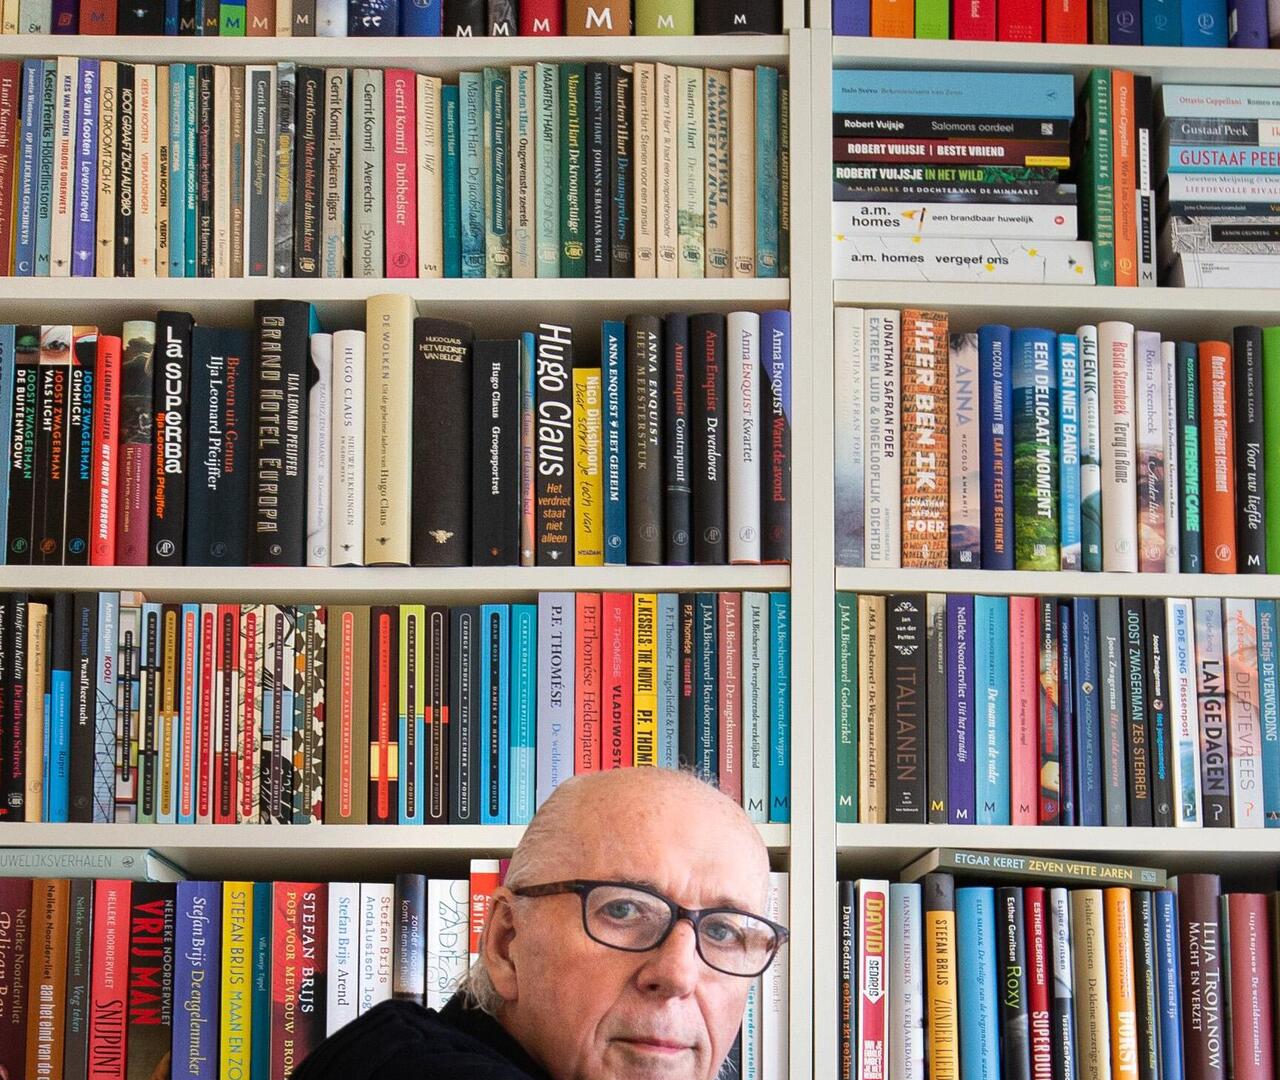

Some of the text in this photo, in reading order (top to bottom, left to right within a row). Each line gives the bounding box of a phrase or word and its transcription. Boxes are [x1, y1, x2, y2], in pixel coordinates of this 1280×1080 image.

[79, 71, 95, 221] Kees van Kooten Levensnevel
[393, 80, 408, 225] Gerrit Komrij Dubbelster
[848, 144, 1004, 157] ROBERT VUIJSJE BESTE VRIEND
[1180, 151, 1246, 166] GUSTAAF
[1181, 124, 1248, 136] Gustaaf Peek
[851, 217, 900, 227] homes
[851, 253, 1008, 265] a.m. homes vergeef ons
[860, 207, 891, 215] a.m.
[204, 356, 222, 490] Ilja Leonard Pfeijffer
[256, 316, 283, 532] GRAND HOTEL EUROPA
[536, 323, 571, 476] Hugo Claus
[914, 321, 936, 488] HIER BEN IK
[1035, 342, 1051, 518] EEN DELICAAT MOMENT
[549, 606, 566, 708] P.F. THOMÉSE
[637, 649, 654, 692] THE NOVEL
[1128, 610, 1147, 798] JOOST ZWAGERMAN ZES STERREN
[896, 666, 918, 780] ITALIANEN
[1202, 660, 1224, 790] LANGE DAGEN
[129, 901, 164, 1024] VRIJ MAN
[866, 897, 883, 953] DAVID
[91, 999, 123, 1077] SNIJPUNT
[1005, 965, 1023, 1008] Roxy
[1203, 921, 1221, 1069] ILIJA TROJANOW
